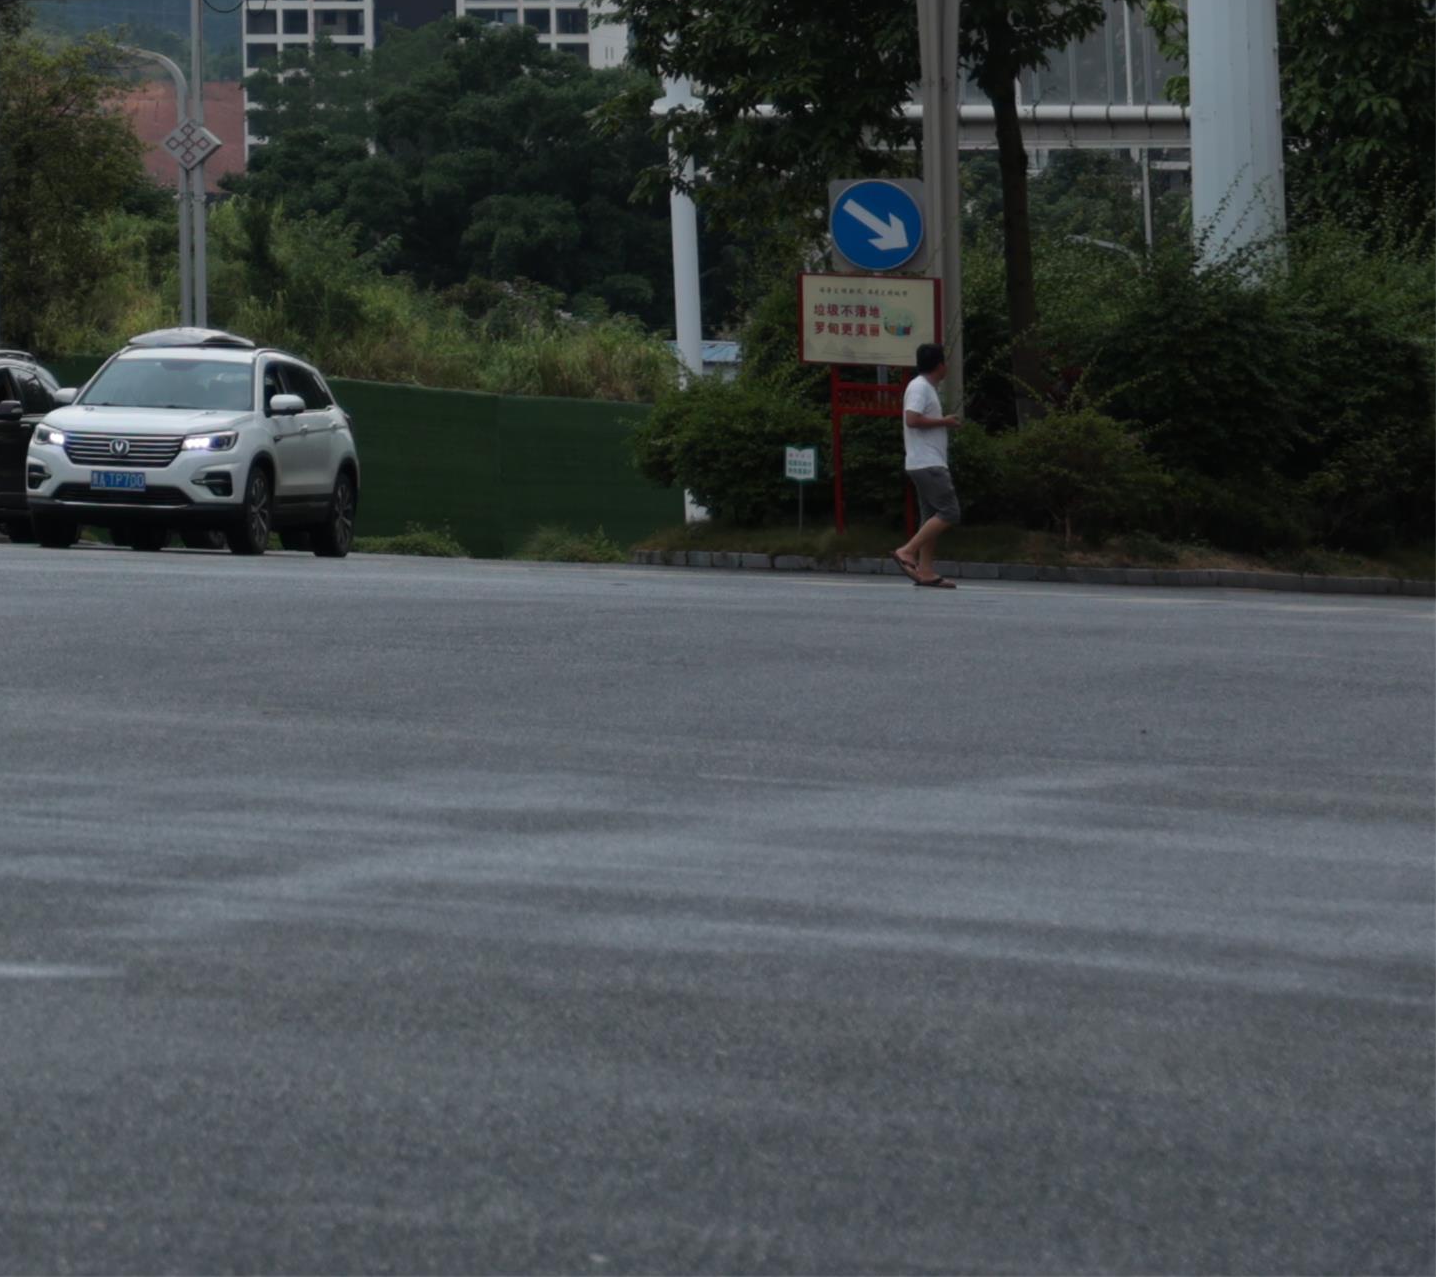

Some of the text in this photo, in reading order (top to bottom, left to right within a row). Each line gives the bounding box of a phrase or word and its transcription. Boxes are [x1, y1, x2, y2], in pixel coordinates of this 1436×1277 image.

[813, 303, 881, 319] 垃圾不落地
[813, 321, 881, 337] 罗甸更美丽
